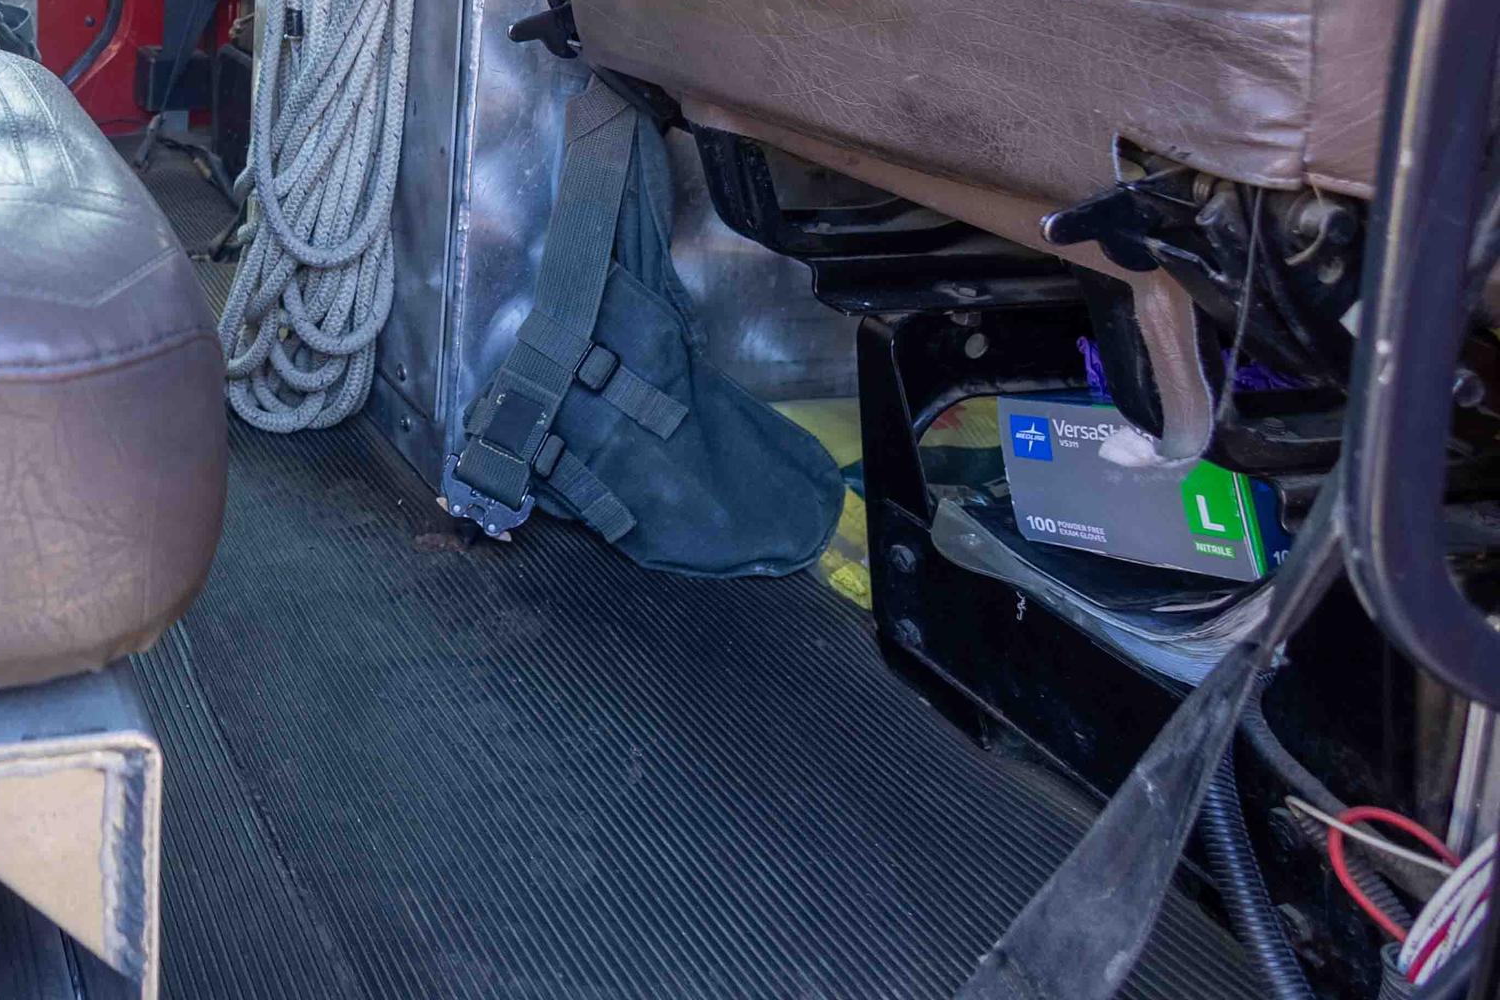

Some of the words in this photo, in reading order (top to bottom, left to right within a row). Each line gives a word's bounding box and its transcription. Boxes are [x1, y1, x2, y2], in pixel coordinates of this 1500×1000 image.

[1196, 494, 1226, 532] L
[1026, 515, 1057, 533] 100
[1057, 520, 1087, 532] POWDER
[1087, 525, 1106, 535] FREE
[1059, 527, 1080, 537] EXAM
[1080, 532, 1107, 543] GLOVES
[1195, 542, 1236, 559] NITRILE
